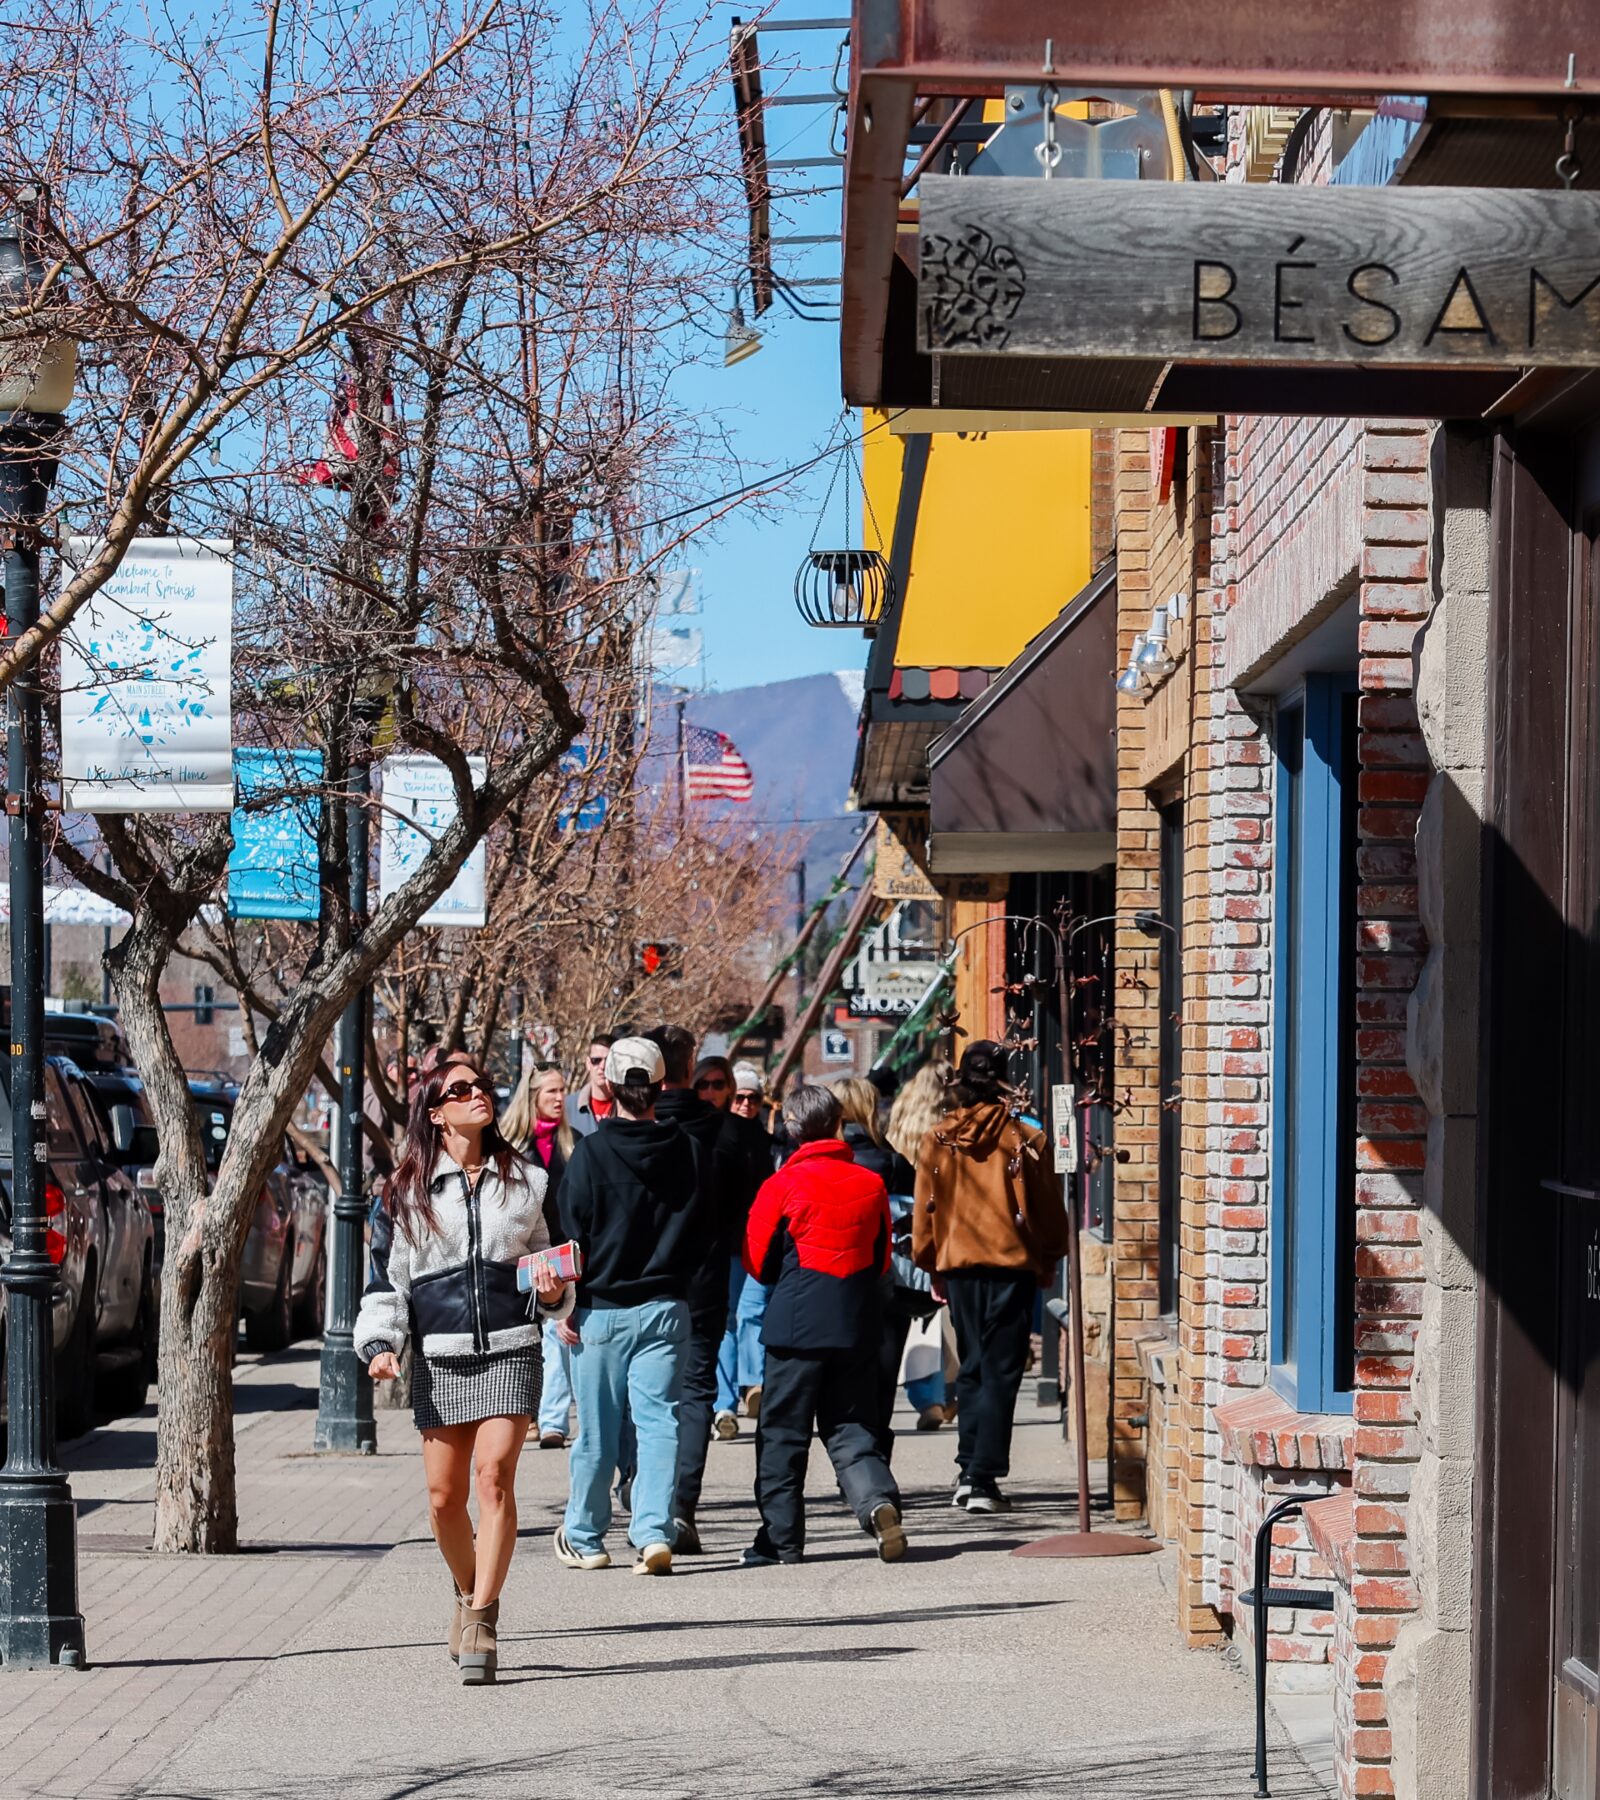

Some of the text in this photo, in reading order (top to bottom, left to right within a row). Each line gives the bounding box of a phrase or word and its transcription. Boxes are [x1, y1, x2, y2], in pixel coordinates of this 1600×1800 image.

[155, 579, 196, 600] Springs
[126, 684, 167, 695] MAIN STREET
[179, 765, 208, 782] Home
[849, 993, 917, 1012] SHOES
